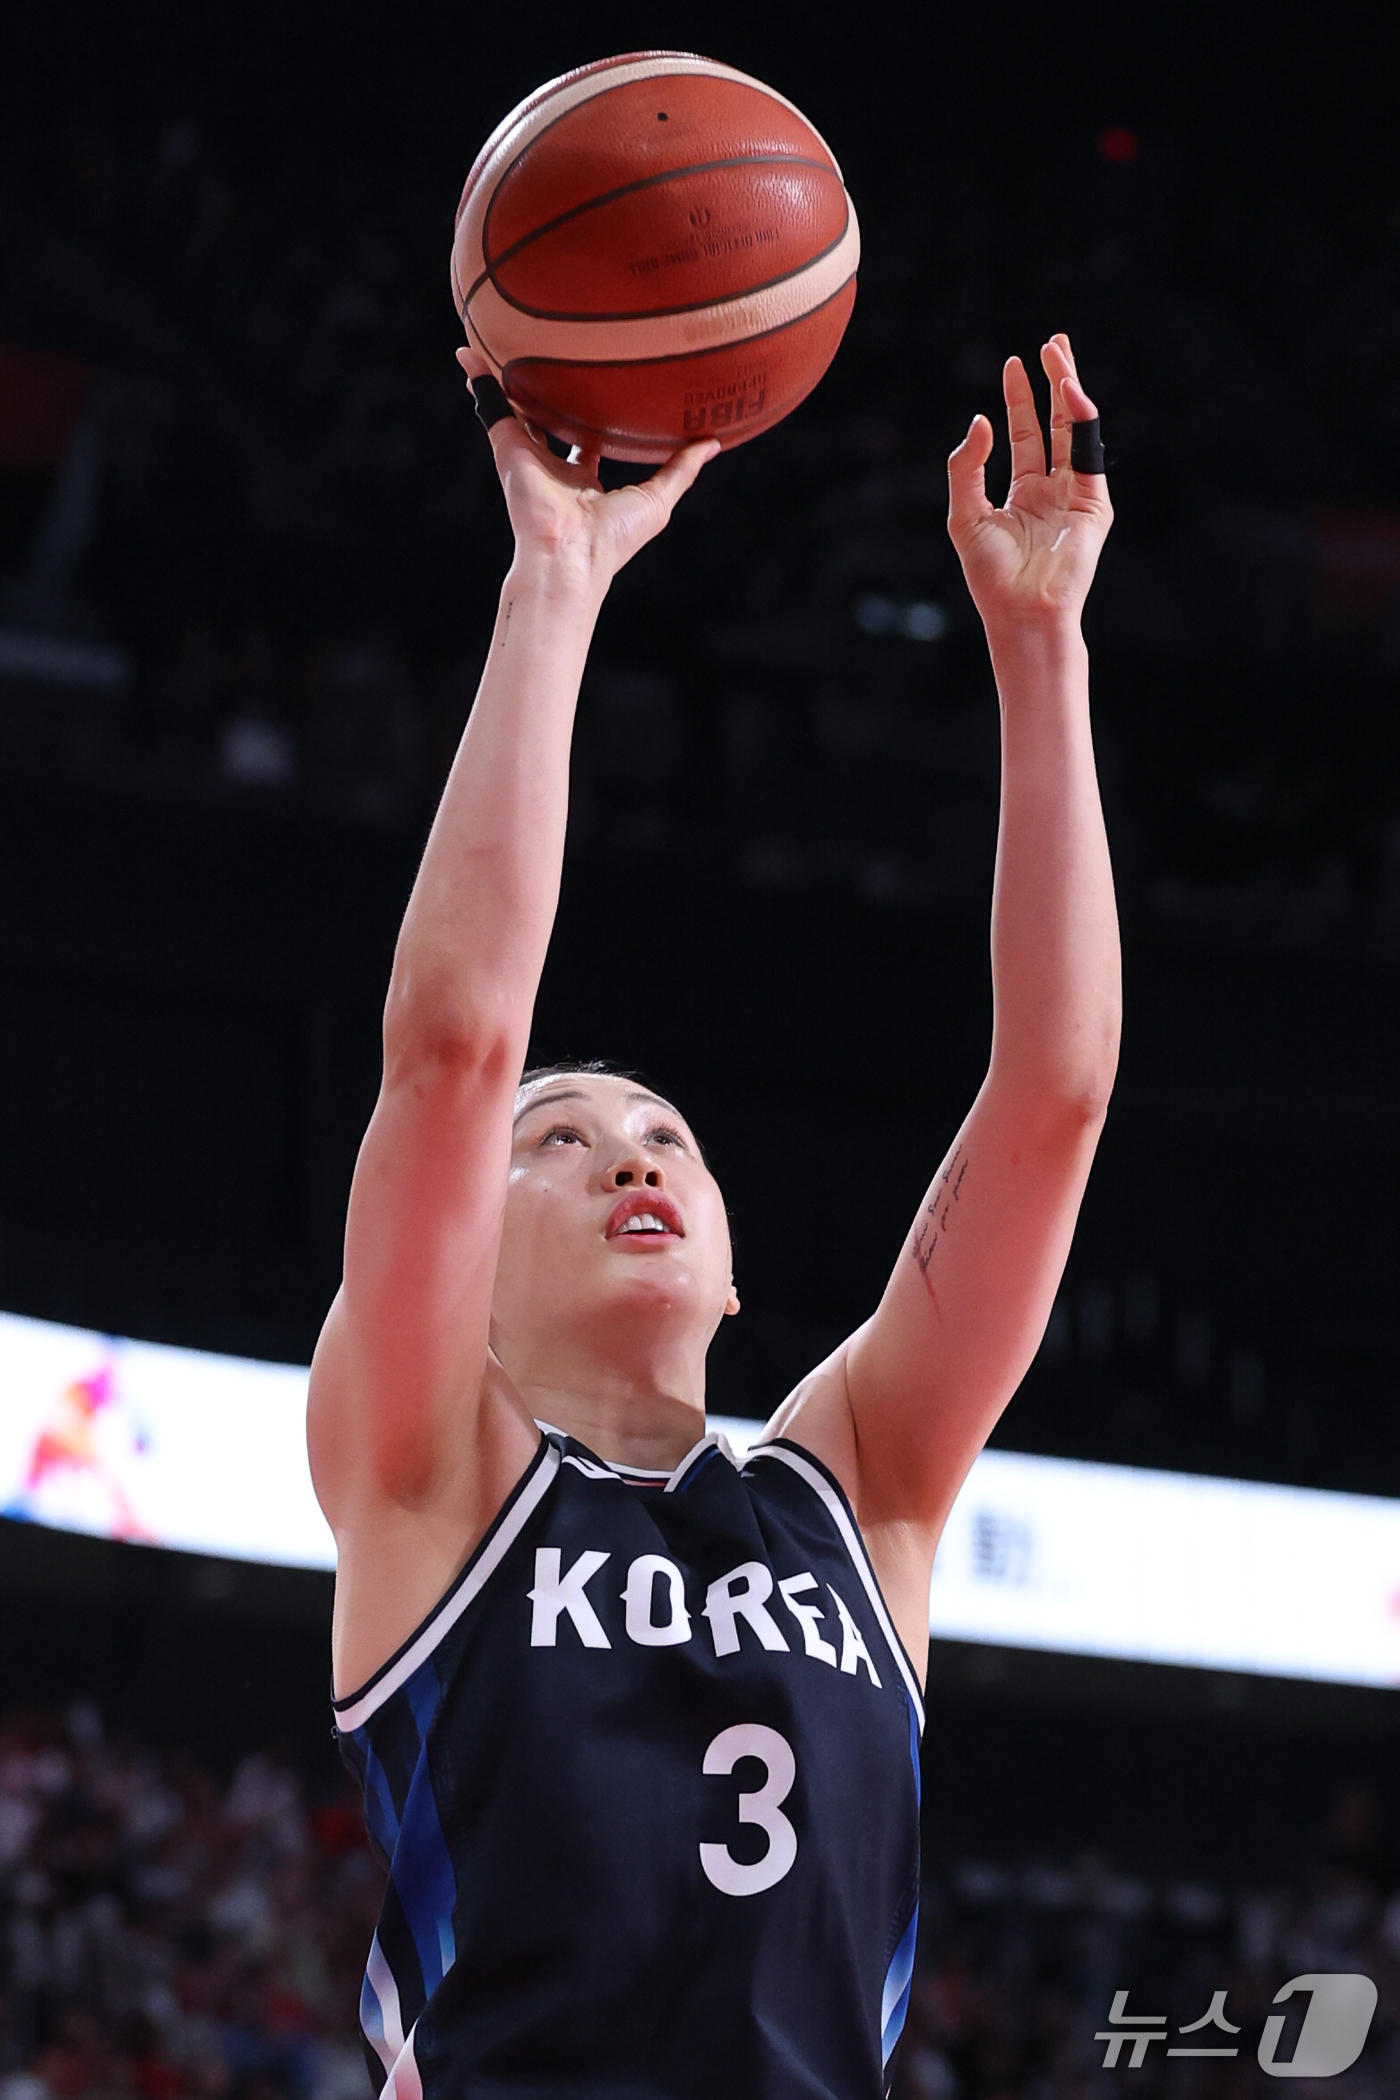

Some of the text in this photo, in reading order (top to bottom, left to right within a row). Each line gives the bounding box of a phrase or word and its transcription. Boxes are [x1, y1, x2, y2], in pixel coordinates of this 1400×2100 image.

[683, 388, 766, 433] FIBA
[526, 1547, 883, 1690] KOREA
[699, 1723, 798, 1896] 3
